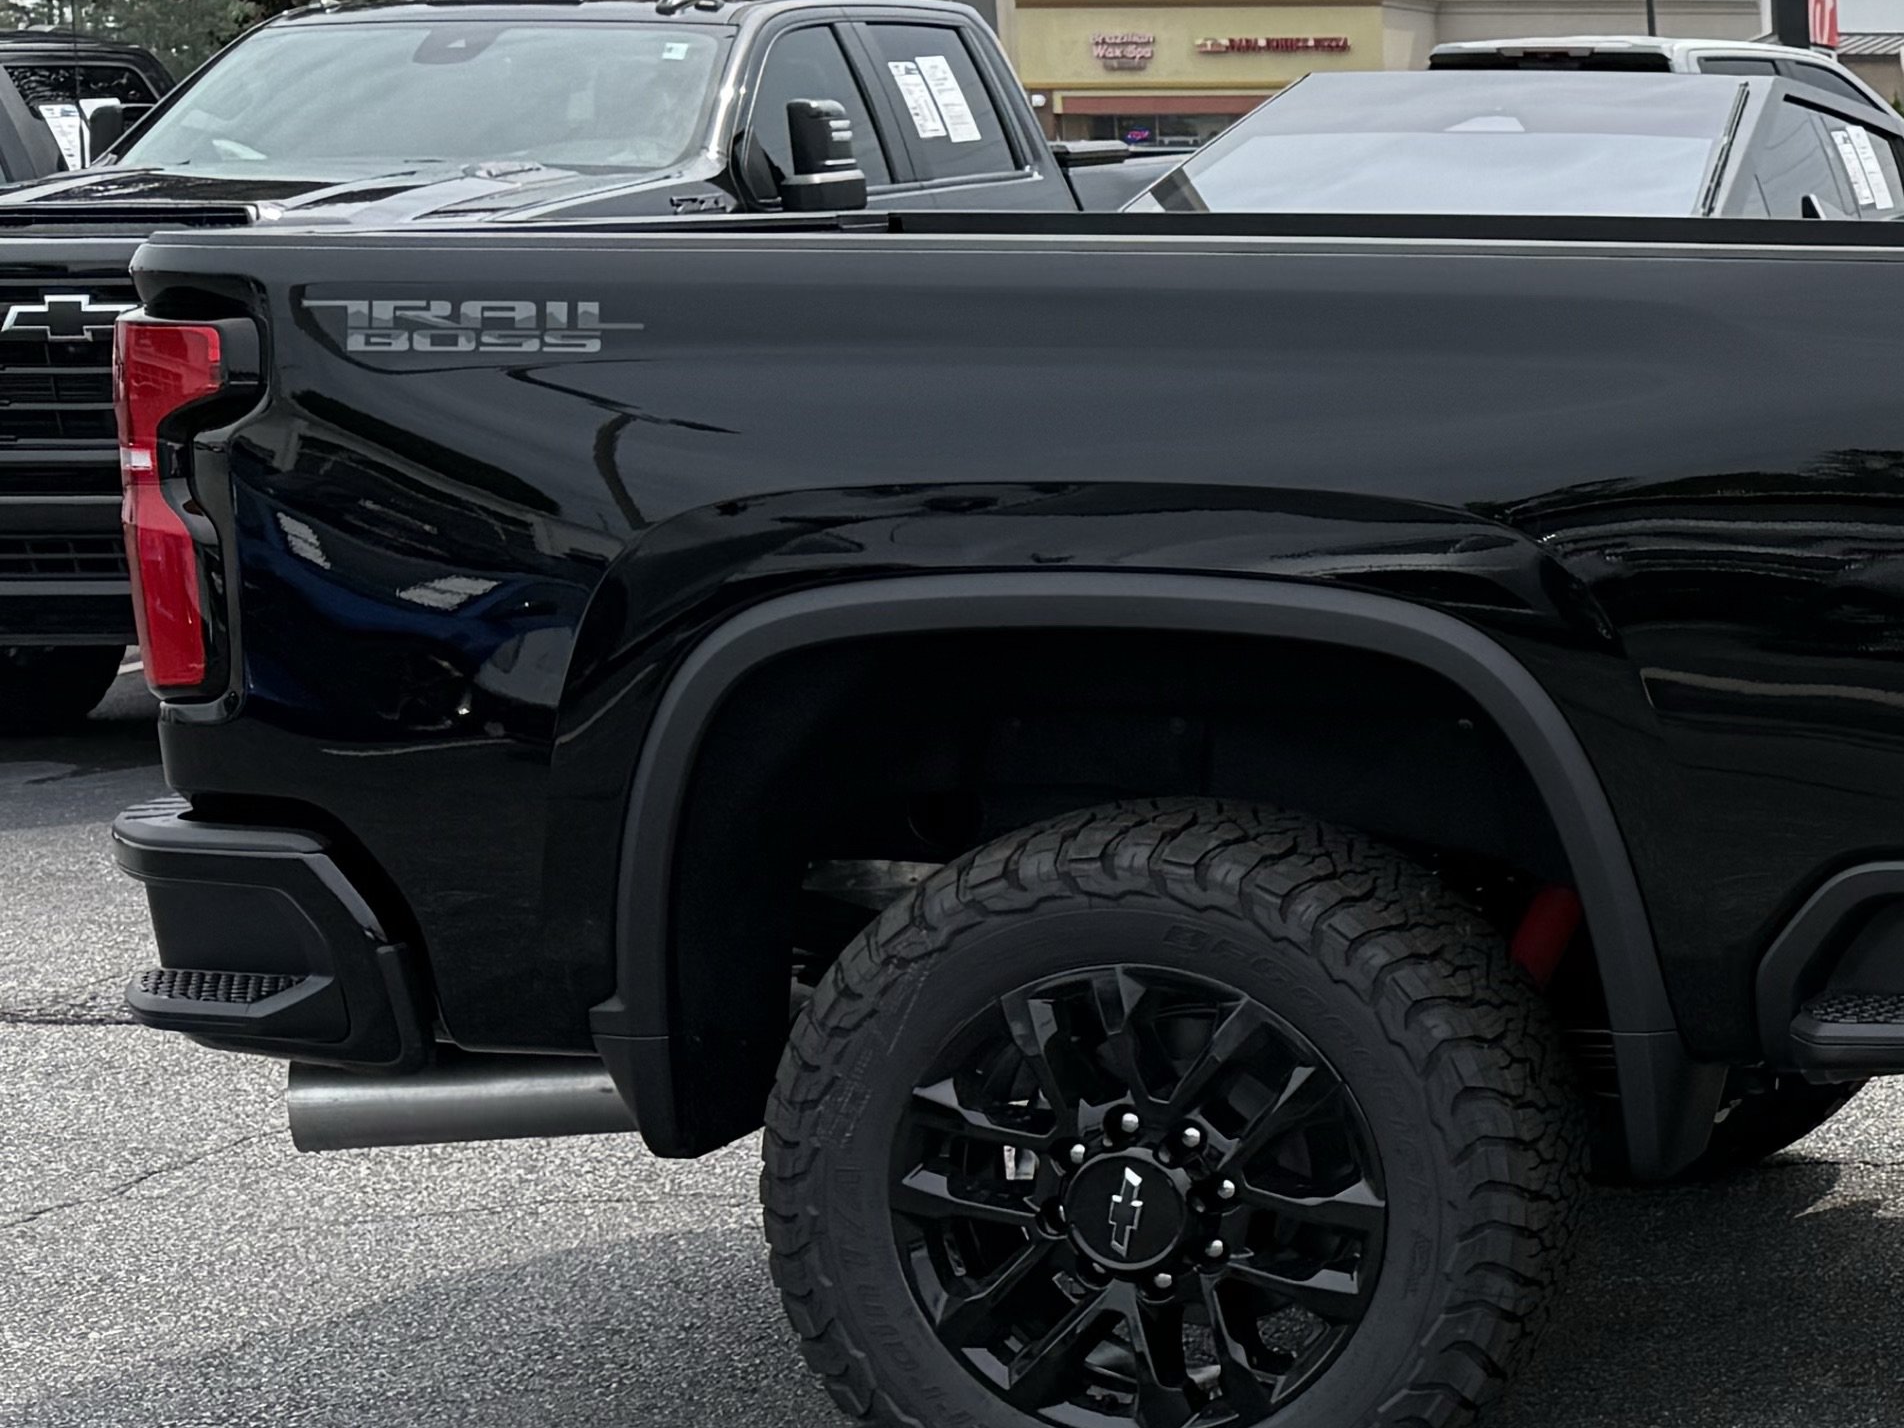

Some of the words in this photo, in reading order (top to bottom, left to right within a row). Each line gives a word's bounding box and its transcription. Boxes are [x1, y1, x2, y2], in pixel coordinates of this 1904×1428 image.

[1093, 44, 1122, 58] Wax
[301, 300, 645, 329] TRAIL
[346, 329, 602, 352] BOSS
